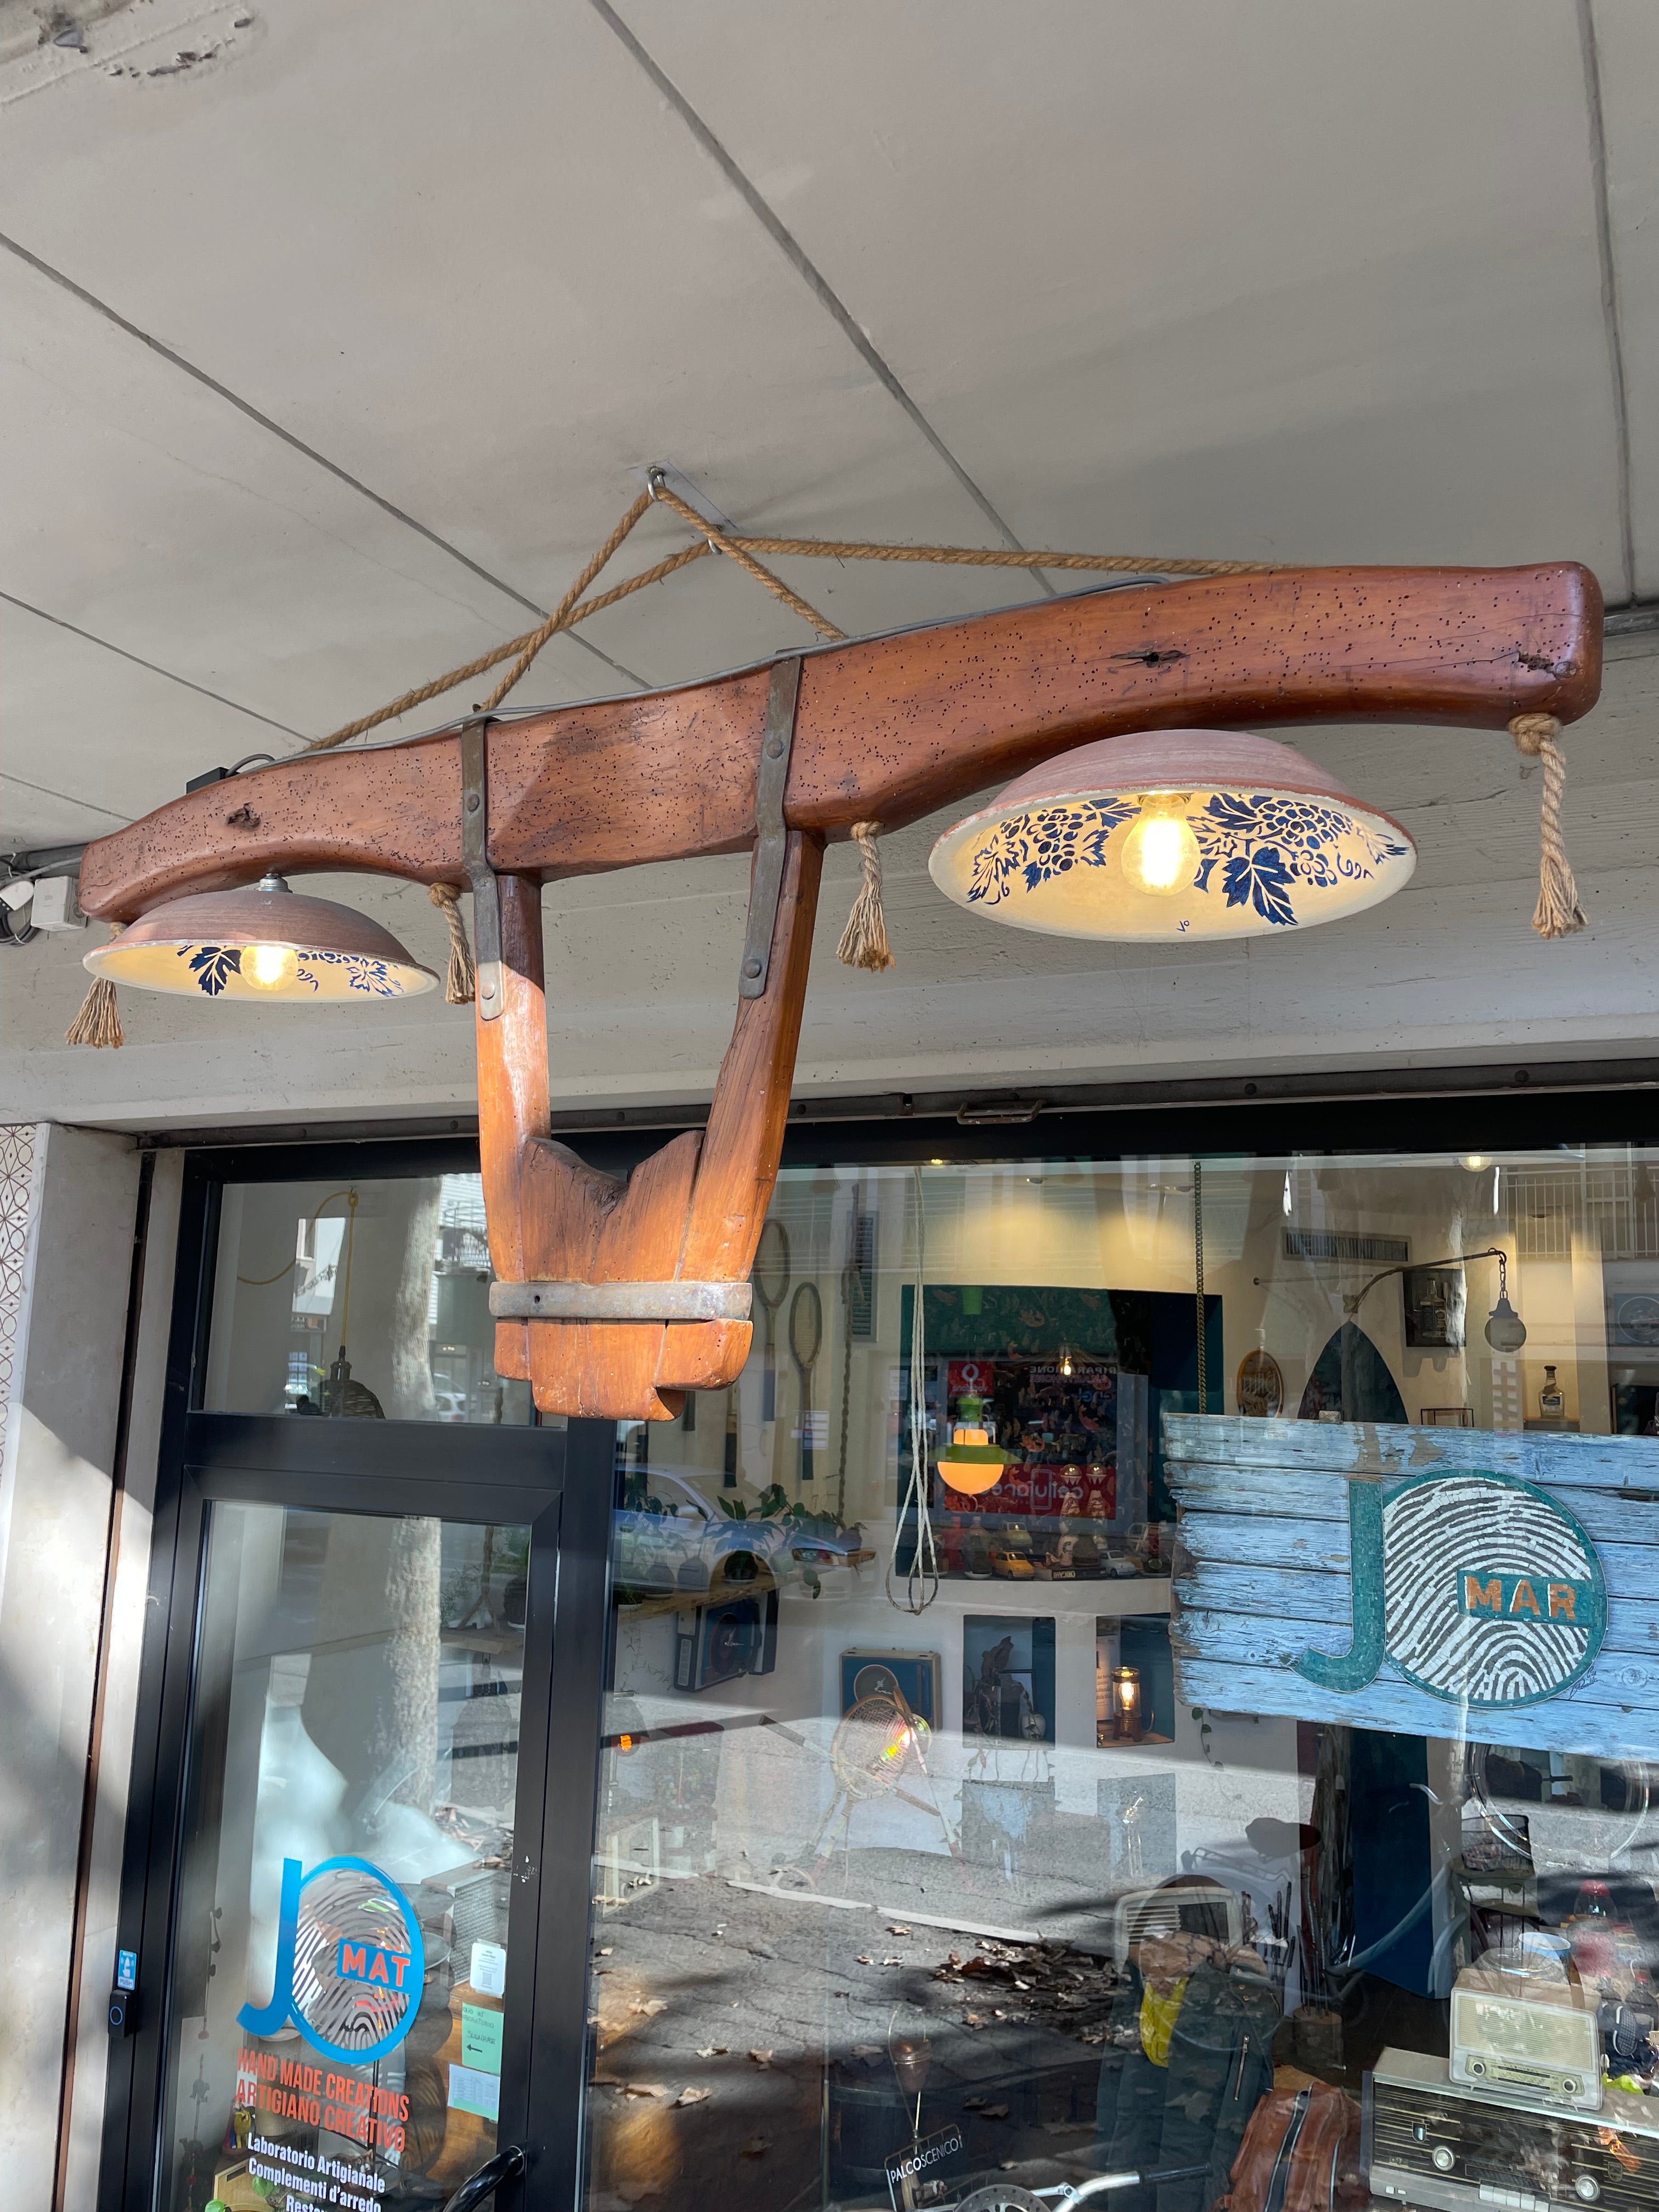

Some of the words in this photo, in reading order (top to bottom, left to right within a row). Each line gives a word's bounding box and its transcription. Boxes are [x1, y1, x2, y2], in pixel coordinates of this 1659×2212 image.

[1464, 1576, 1576, 1620] MAR
[119, 1978, 133, 1986] PUSH
[342, 1944, 410, 1987] MAT
[238, 2047, 276, 2081] HAND
[280, 2059, 323, 2096] MADE
[326, 2073, 409, 2121] CREATIONS
[236, 2079, 320, 2126] ARTIGIANO
[324, 2106, 405, 2153] CREATIVO
[247, 2132, 315, 2171] Laboratorio
[317, 2155, 385, 2193] Artigianale
[249, 2158, 327, 2199] Complementi
[890, 2138, 958, 2183] PALCOSCENICO
